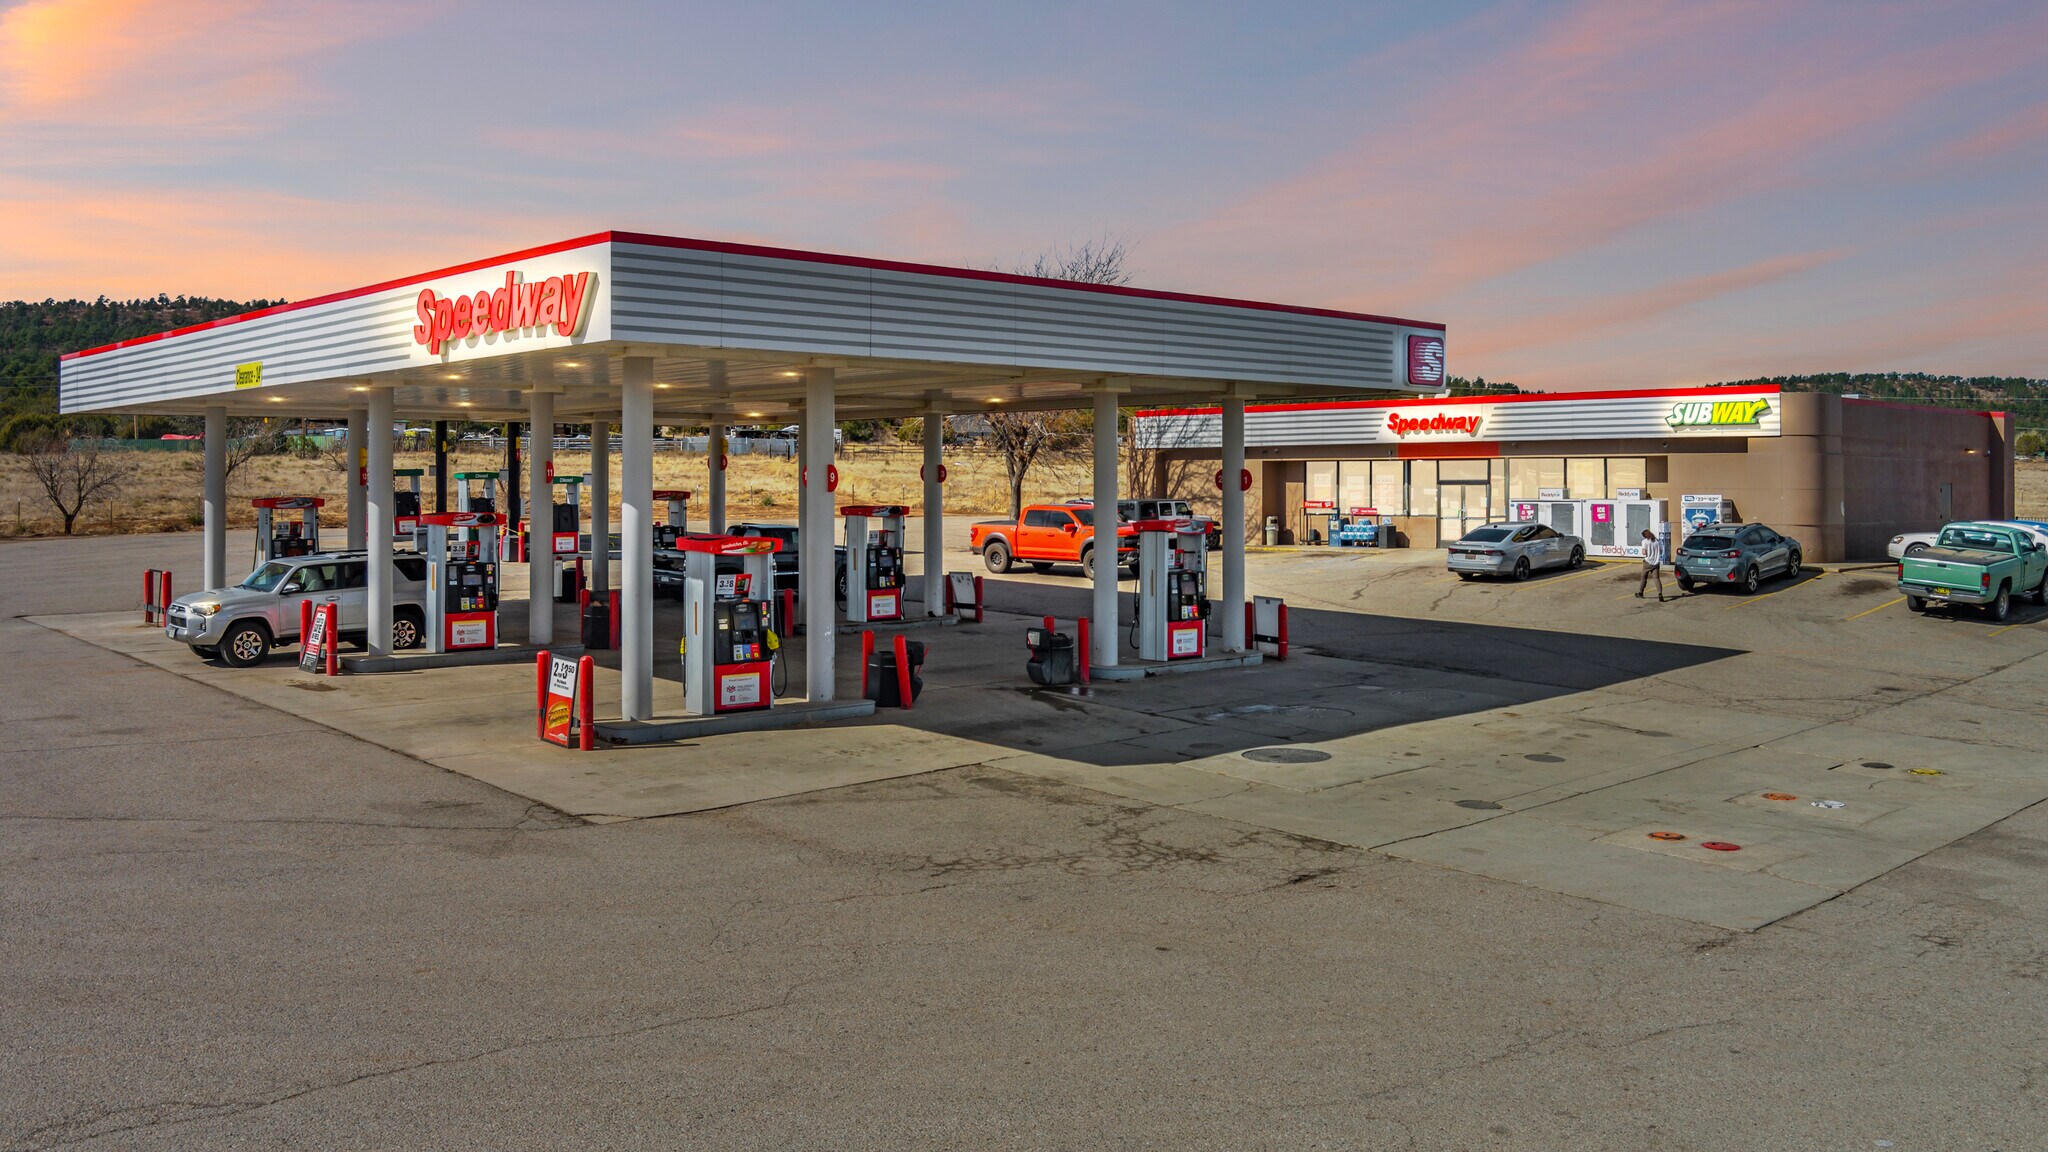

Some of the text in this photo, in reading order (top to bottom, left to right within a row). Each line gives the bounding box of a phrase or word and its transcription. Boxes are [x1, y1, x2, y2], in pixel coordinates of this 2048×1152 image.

[414, 271, 591, 354] Speedway
[1665, 398, 1769, 427] SUBWAY
[1387, 413, 1480, 435] Speedway
[547, 468, 553, 477] 11
[830, 472, 835, 483] 9
[940, 470, 945, 478] 3
[1243, 475, 1248, 485] 1
[719, 580, 725, 588] 3
[553, 662, 559, 676] 2
